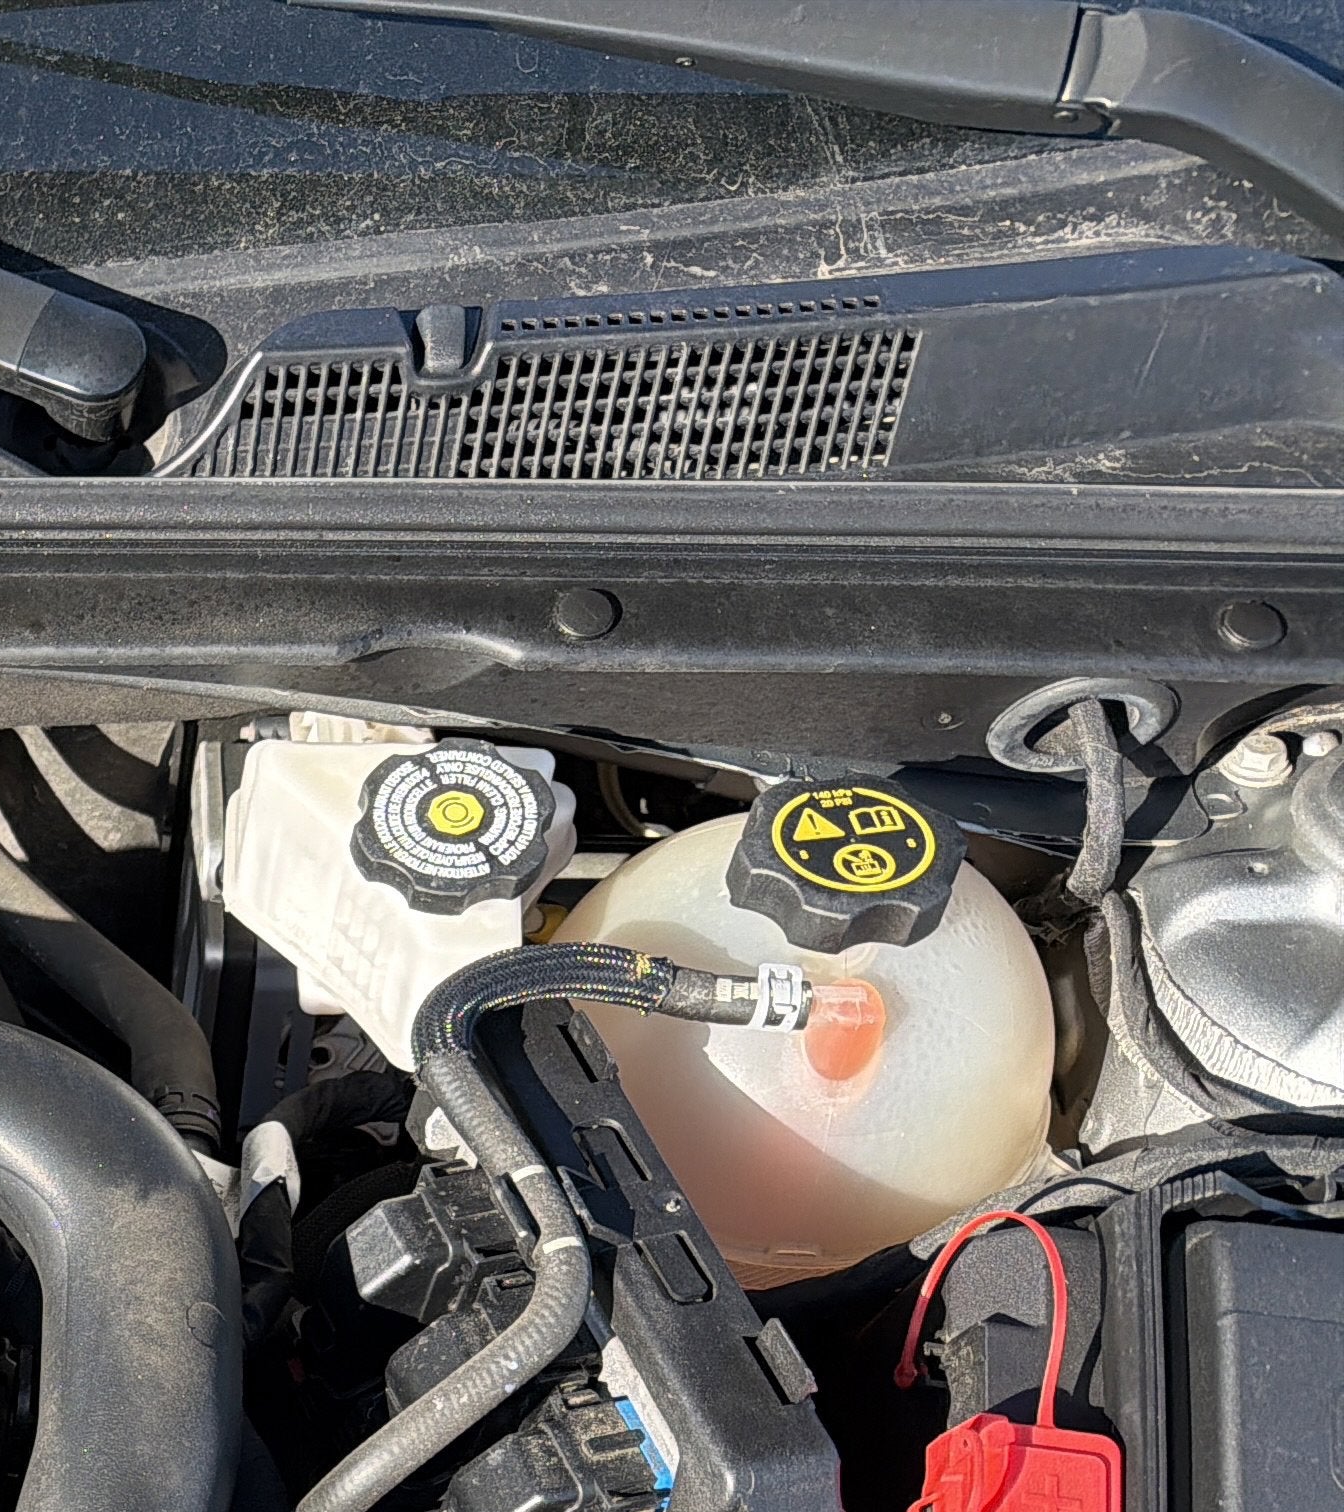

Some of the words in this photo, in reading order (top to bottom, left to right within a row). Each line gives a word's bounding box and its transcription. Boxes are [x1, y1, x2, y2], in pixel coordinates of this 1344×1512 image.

[440, 773, 478, 786] FILLER
[490, 760, 526, 788] SEALED
[475, 780, 504, 806] CLEAN
[518, 785, 531, 793] A
[812, 790, 832, 800] 140
[521, 792, 537, 818] FROM
[820, 799, 835, 808] 20
[834, 797, 853, 806] PSI
[517, 819, 537, 845] FLUID
